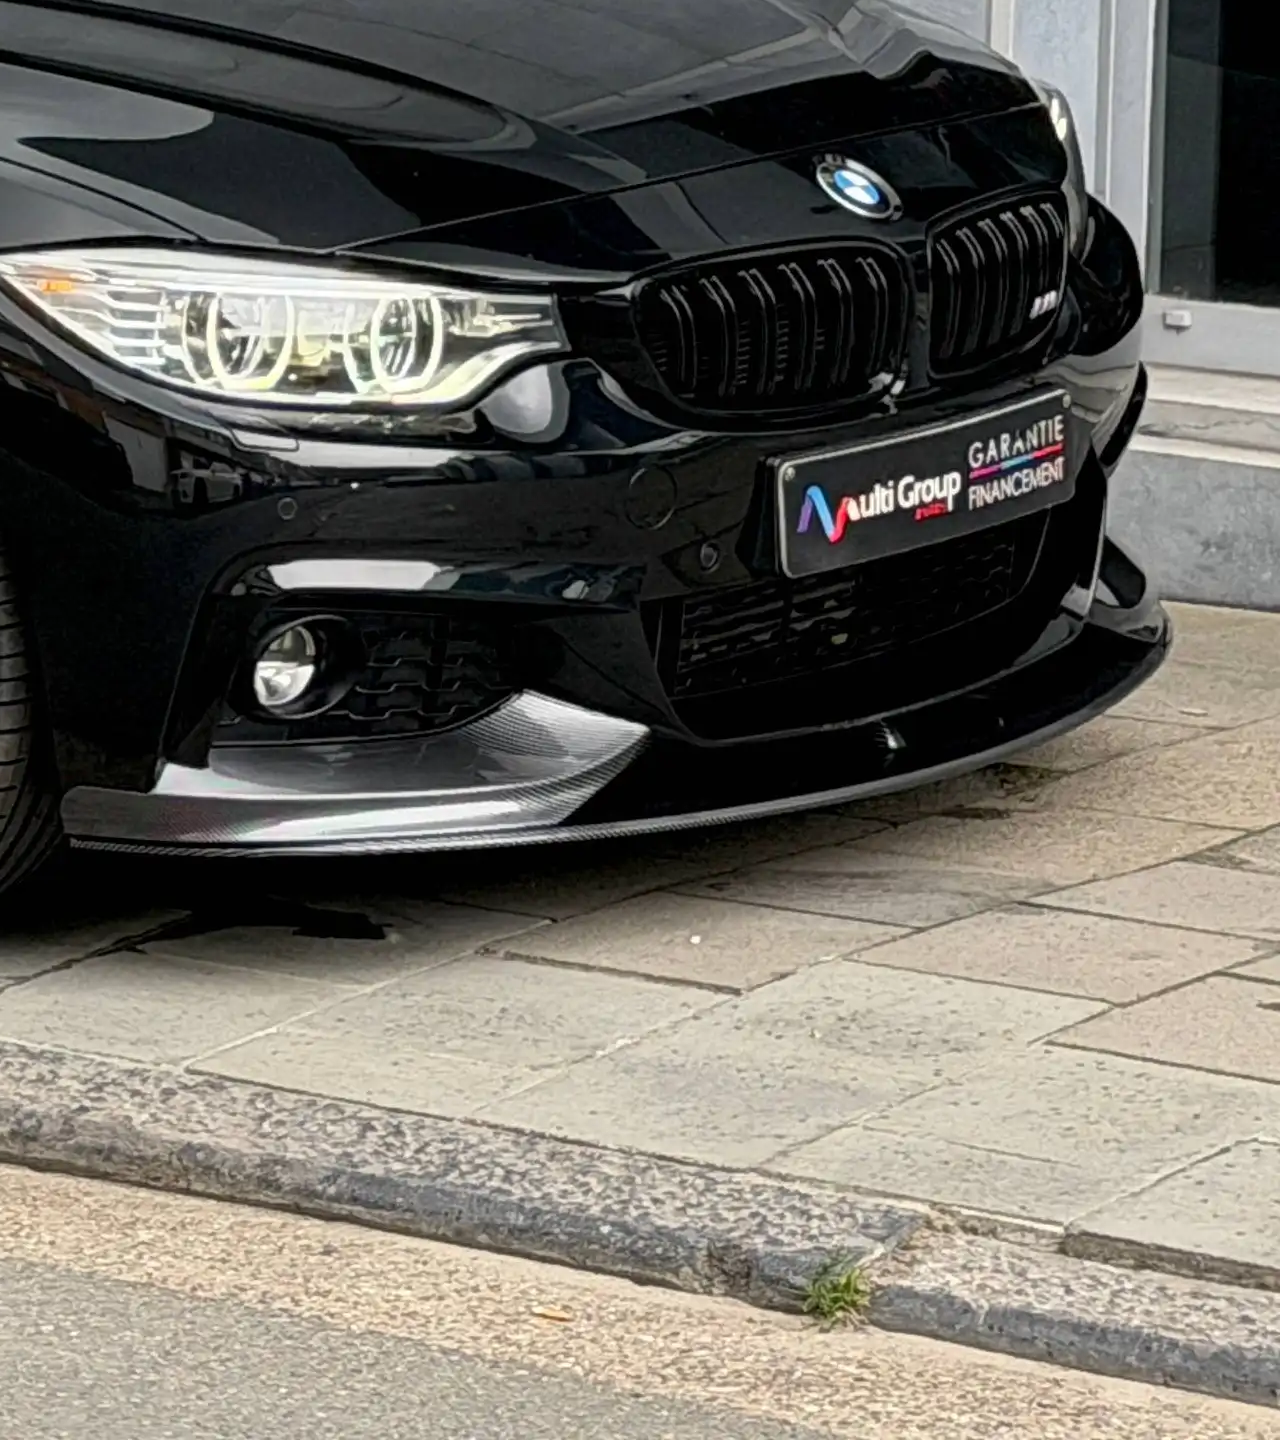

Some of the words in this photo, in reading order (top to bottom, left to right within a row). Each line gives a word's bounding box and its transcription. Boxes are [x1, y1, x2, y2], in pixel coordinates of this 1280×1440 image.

[968, 414, 1065, 469] GARANTIE
[897, 471, 962, 512] Group
[968, 456, 1066, 511] FINANCEMENT
